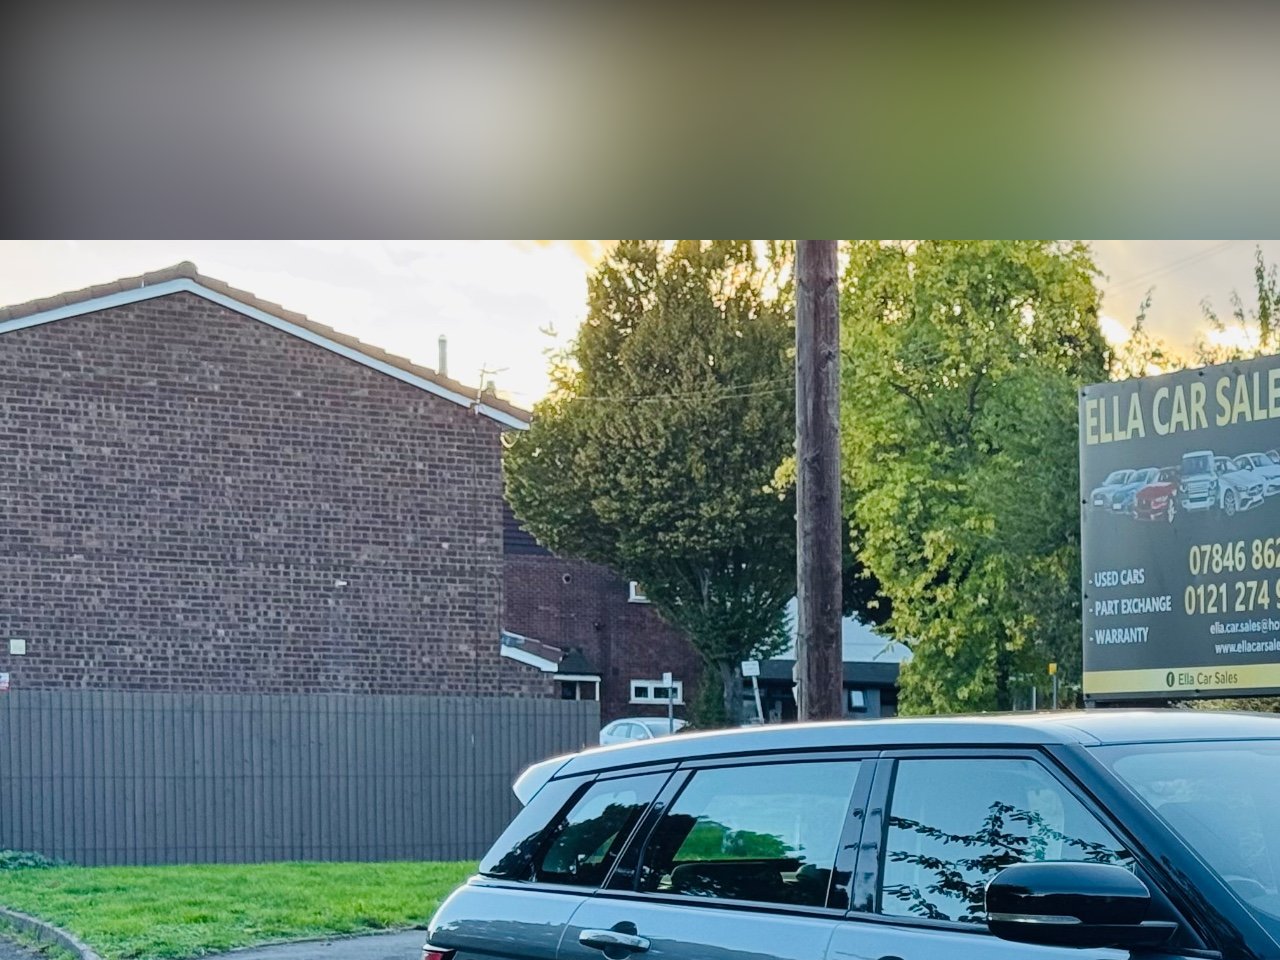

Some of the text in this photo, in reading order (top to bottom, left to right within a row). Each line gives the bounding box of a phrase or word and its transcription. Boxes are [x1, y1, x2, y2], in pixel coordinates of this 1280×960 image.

[1085, 392, 1146, 445] ELLA
[1152, 381, 1209, 436] CAR
[1189, 540, 1247, 576] 07846
[1094, 568, 1145, 588] USED CARS
[1095, 595, 1172, 616] PART EXCHANGE
[1184, 582, 1228, 615] 0121
[1234, 579, 1270, 612] 274
[1095, 626, 1149, 645] WARRANTY
[1178, 671, 1238, 686] Ella Car Sales
